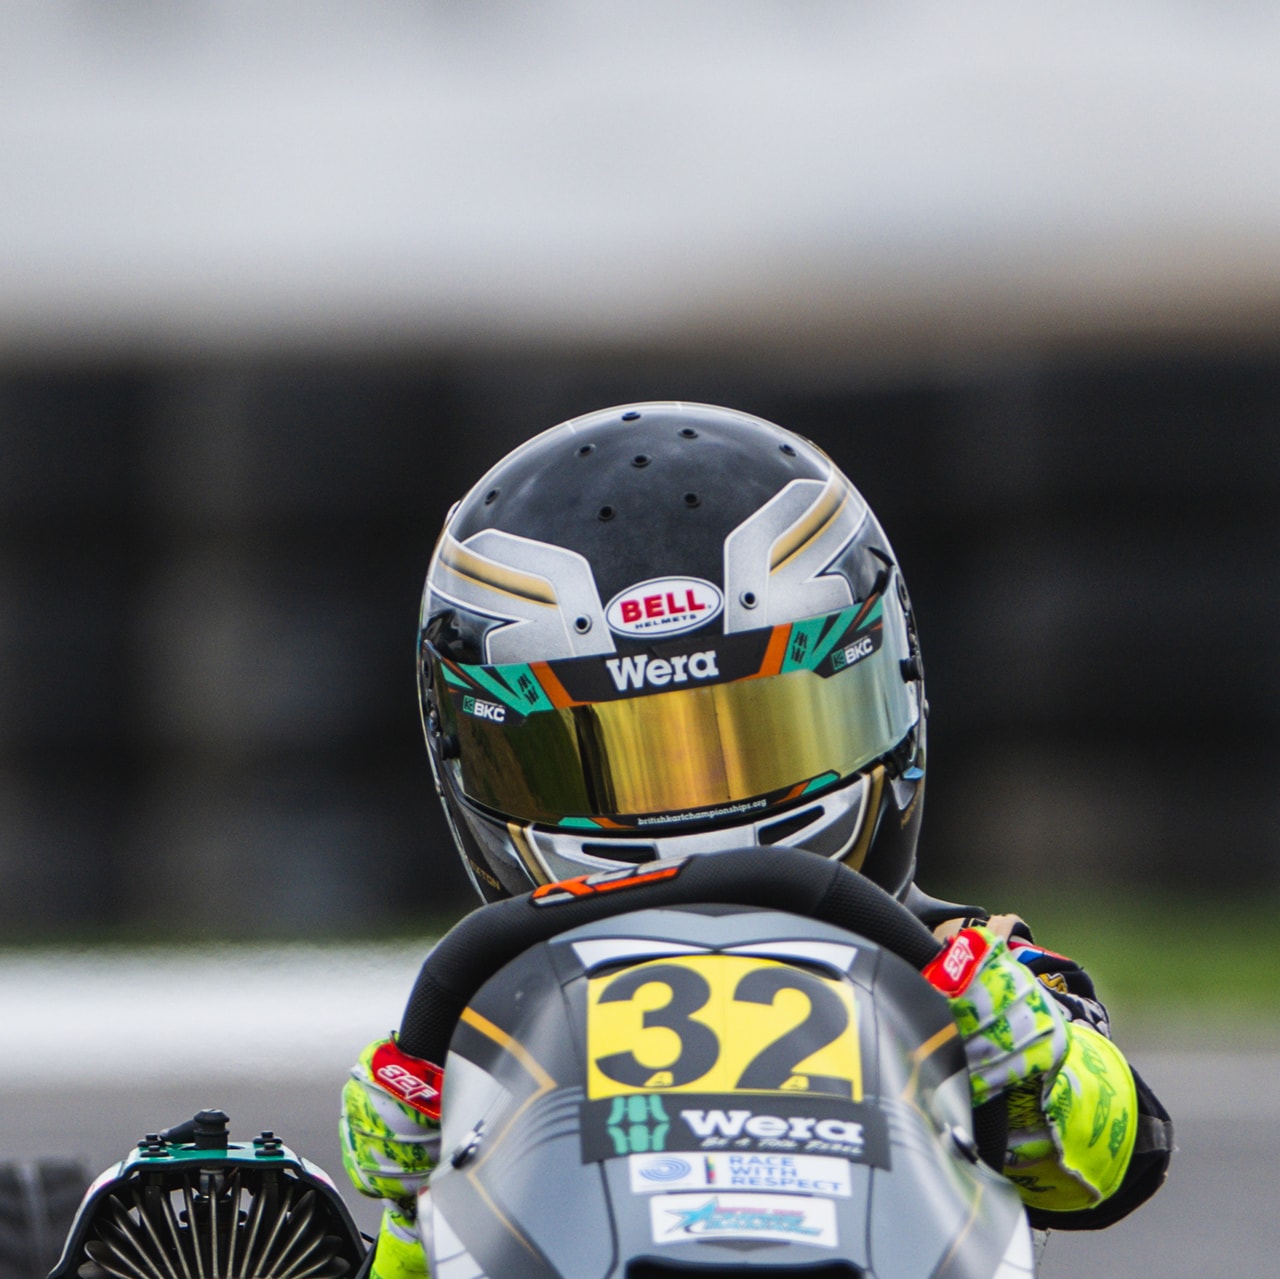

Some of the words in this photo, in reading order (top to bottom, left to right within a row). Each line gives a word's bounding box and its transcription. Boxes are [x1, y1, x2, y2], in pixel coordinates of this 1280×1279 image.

[620, 588, 706, 623] BELL
[635, 613, 697, 629] HELMETS
[844, 638, 874, 664] BKC
[606, 650, 719, 691] Wera
[474, 701, 506, 722] BKC
[637, 799, 767, 825] britishkartchampionships.org
[595, 963, 854, 1097] 32
[681, 1110, 864, 1145] Wera
[728, 1155, 796, 1167] RACE
[730, 1166, 798, 1177] WITH
[730, 1177, 843, 1191] RESPECT
